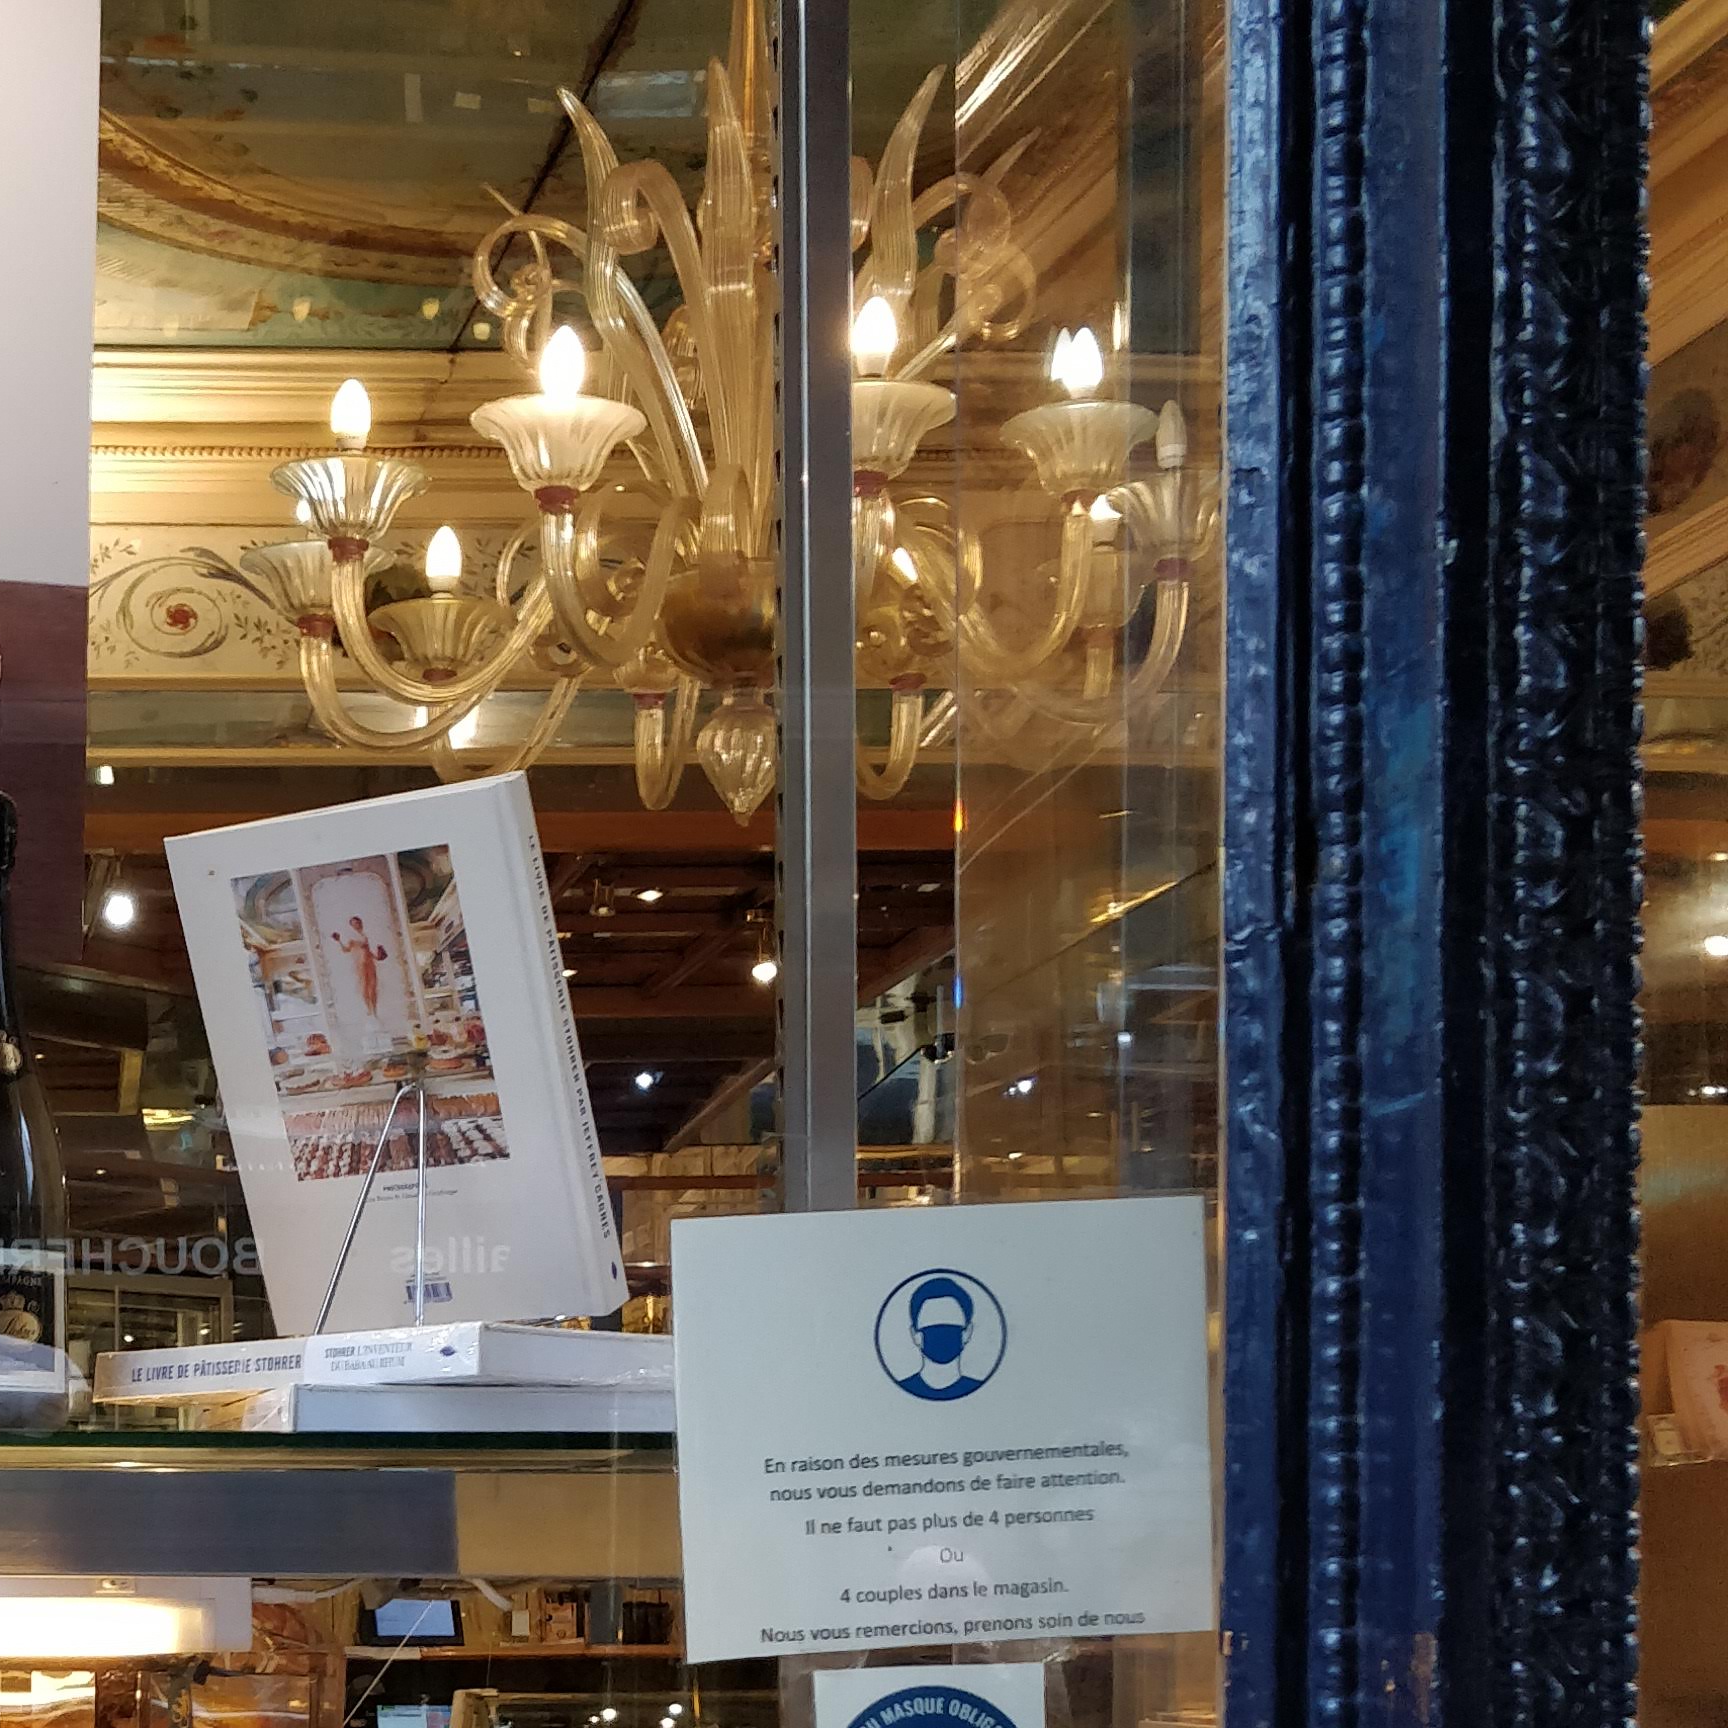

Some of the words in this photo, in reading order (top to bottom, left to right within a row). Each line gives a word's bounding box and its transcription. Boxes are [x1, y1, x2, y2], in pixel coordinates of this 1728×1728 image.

[576, 1089, 587, 1116] PAR
[132, 1367, 143, 1383] LE
[146, 1364, 173, 1381] LIVRE
[177, 1362, 190, 1378] DE
[255, 1353, 302, 1373] STOHRER
[764, 1457, 786, 1474] En
[790, 1454, 844, 1472] raison
[848, 1452, 880, 1470] des
[884, 1450, 959, 1468] mesures
[963, 1440, 1129, 1467] gouvernementales,
[769, 1486, 813, 1502] nous
[816, 1484, 857, 1499] vous
[862, 1476, 965, 1498] demandons
[970, 1473, 991, 1491] de
[996, 1471, 1035, 1490] faire
[1040, 1469, 1126, 1488] attention.
[805, 1519, 816, 1535] Il
[820, 1520, 842, 1535] ne
[846, 1516, 882, 1534] faut
[887, 1516, 918, 1535] pas
[921, 1512, 958, 1533] plus
[962, 1510, 984, 1528] de
[989, 1510, 1000, 1526] 4
[1004, 1506, 1095, 1528] personnes
[939, 1547, 965, 1564] Ou
[840, 1587, 851, 1604] 4
[855, 1583, 922, 1606] couples
[926, 1582, 969, 1599] dans
[972, 1580, 989, 1597] le
[992, 1576, 1070, 1599] magasin.
[760, 1627, 805, 1644] Nous
[809, 1625, 850, 1640] vous
[855, 1617, 959, 1640] remercions,
[964, 1614, 1033, 1637] prenons
[1038, 1611, 1072, 1630] soin
[1077, 1610, 1099, 1627] de
[1103, 1609, 1146, 1626] nous
[879, 1696, 945, 1727] MASQUE
